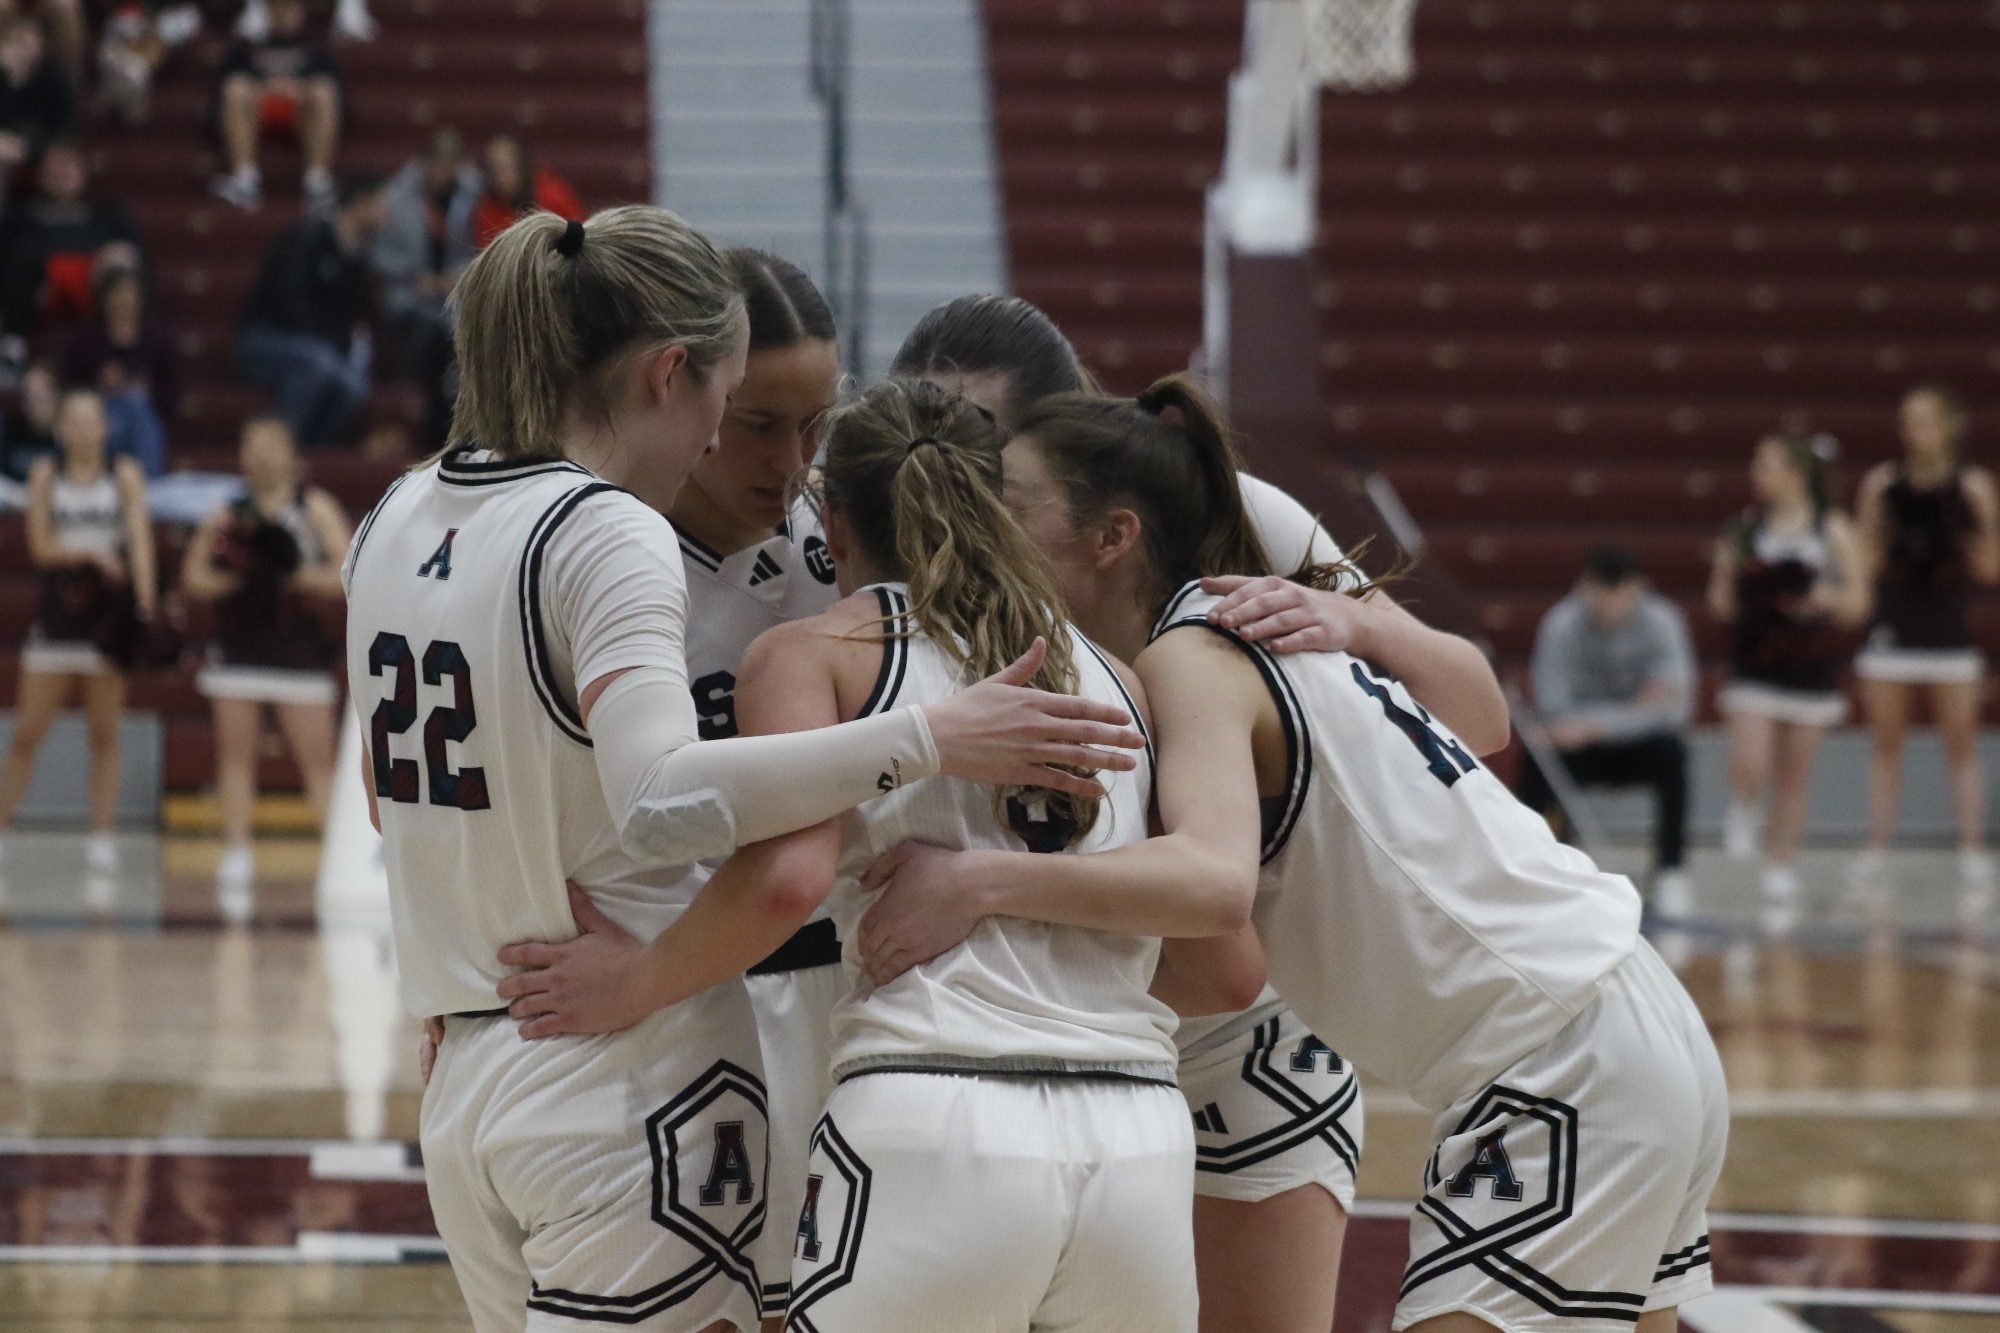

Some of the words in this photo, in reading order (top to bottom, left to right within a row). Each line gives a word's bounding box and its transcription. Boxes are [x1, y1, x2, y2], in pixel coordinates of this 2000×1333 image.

[417, 528, 459, 580] A
[369, 631, 491, 811] 22
[700, 1120, 754, 1206] A
[1445, 1125, 1523, 1202] A
